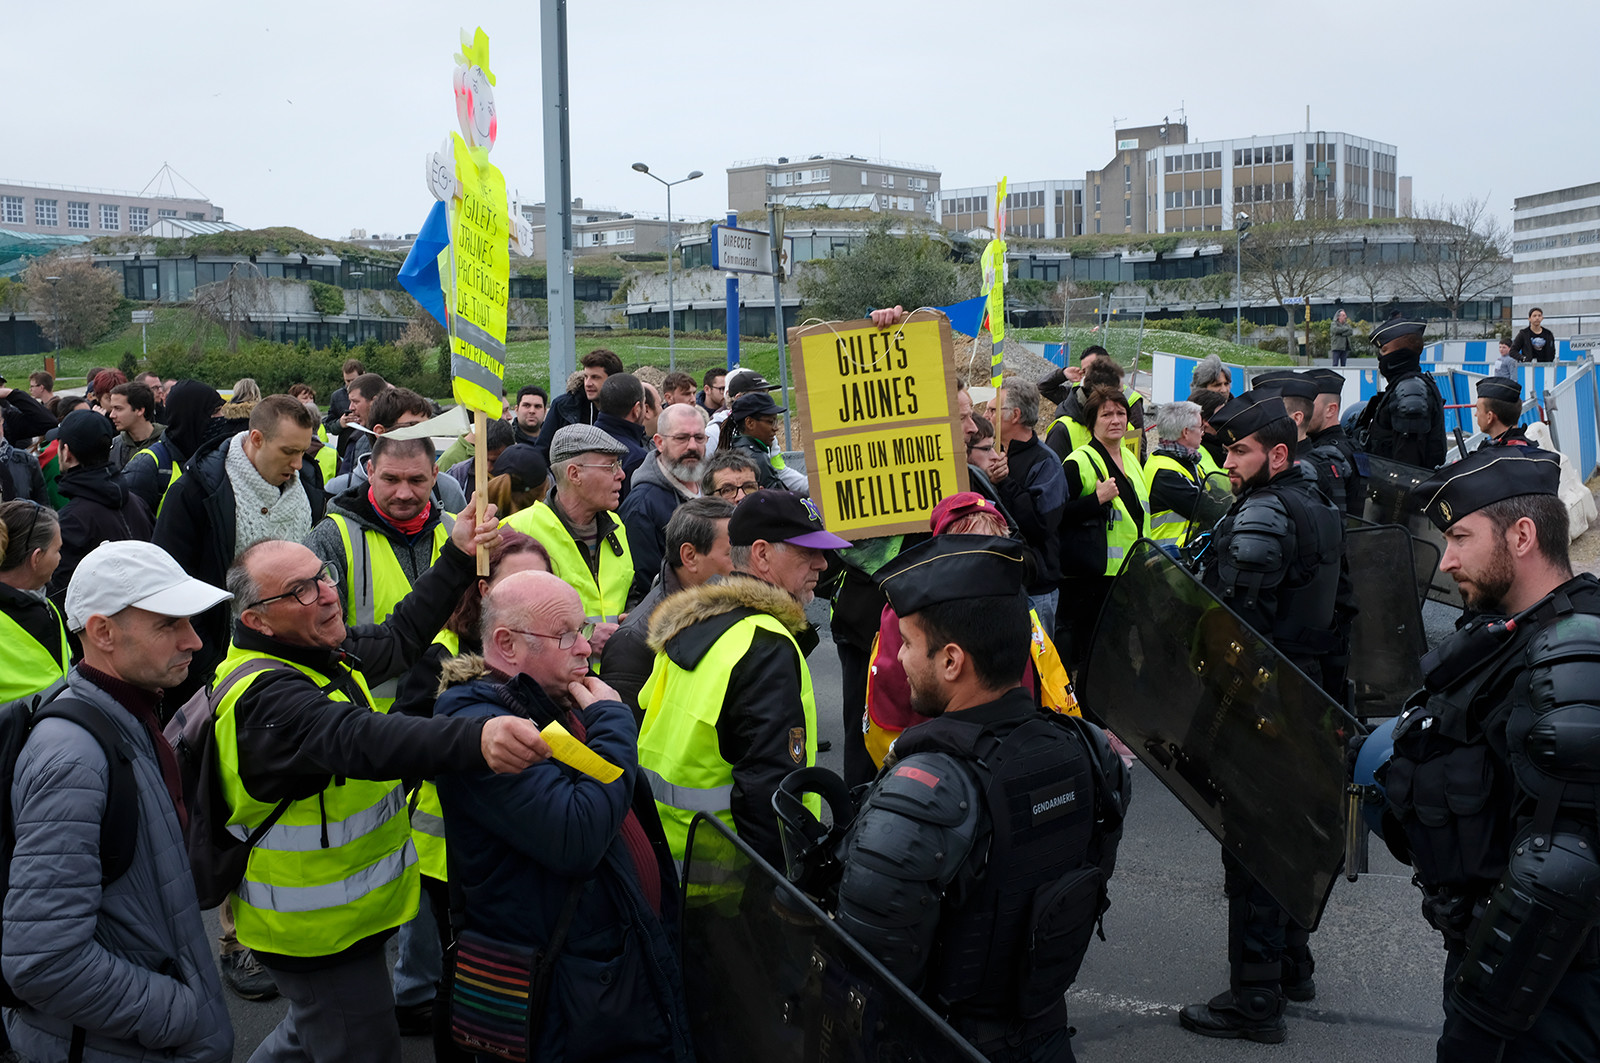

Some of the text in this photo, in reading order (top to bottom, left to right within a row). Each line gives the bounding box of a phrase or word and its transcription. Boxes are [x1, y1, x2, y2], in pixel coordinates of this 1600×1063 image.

[464, 193, 497, 236] GILETS
[459, 223, 494, 268] JAUNES
[723, 234, 752, 250] DIRECCTE
[458, 288, 469, 317] DE
[835, 330, 908, 376] GILETS
[839, 375, 918, 422] JAUNES
[825, 434, 944, 475] POUR UN MONDE
[836, 469, 943, 521] MEILLEUR
[1032, 791, 1075, 815] GENDARMERIE
